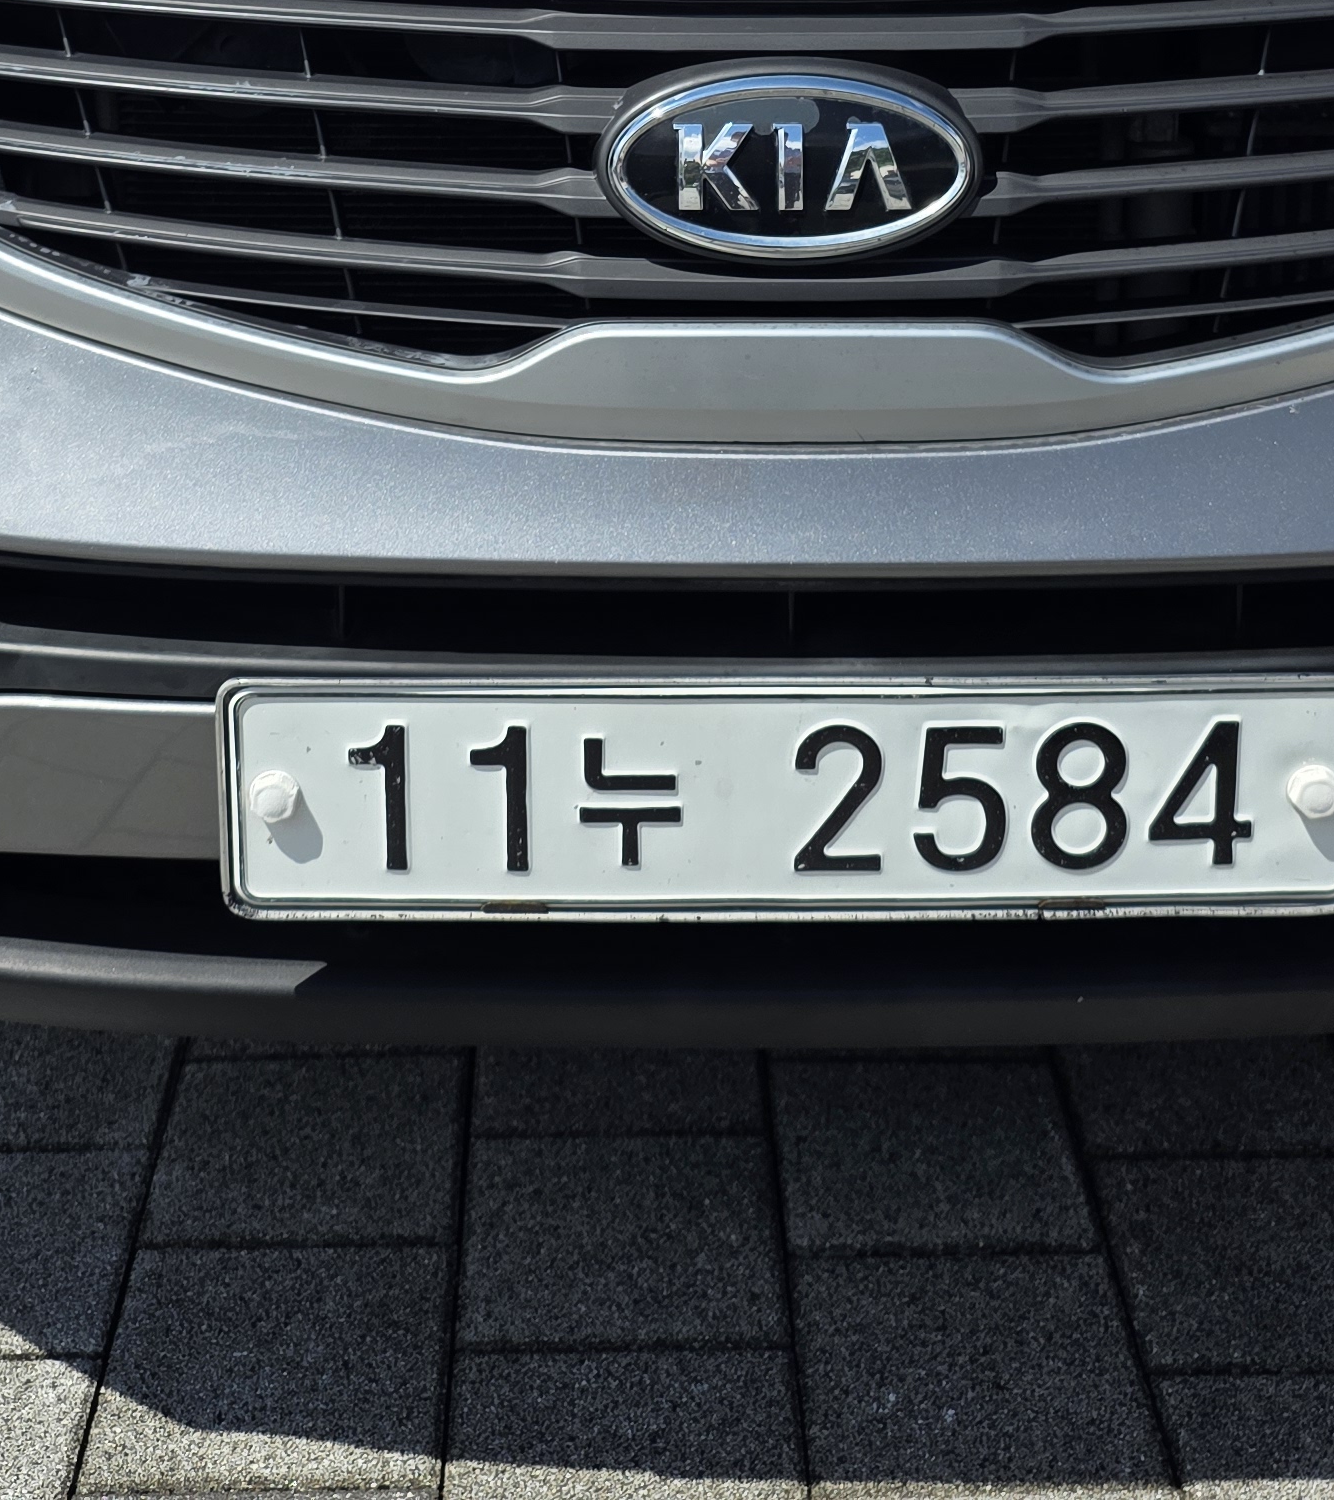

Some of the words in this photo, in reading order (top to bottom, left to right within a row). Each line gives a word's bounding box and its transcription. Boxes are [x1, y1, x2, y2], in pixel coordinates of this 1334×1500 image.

[672, 121, 912, 211] KIA
[348, 723, 683, 872] 11누
[791, 719, 1255, 872] 2584
